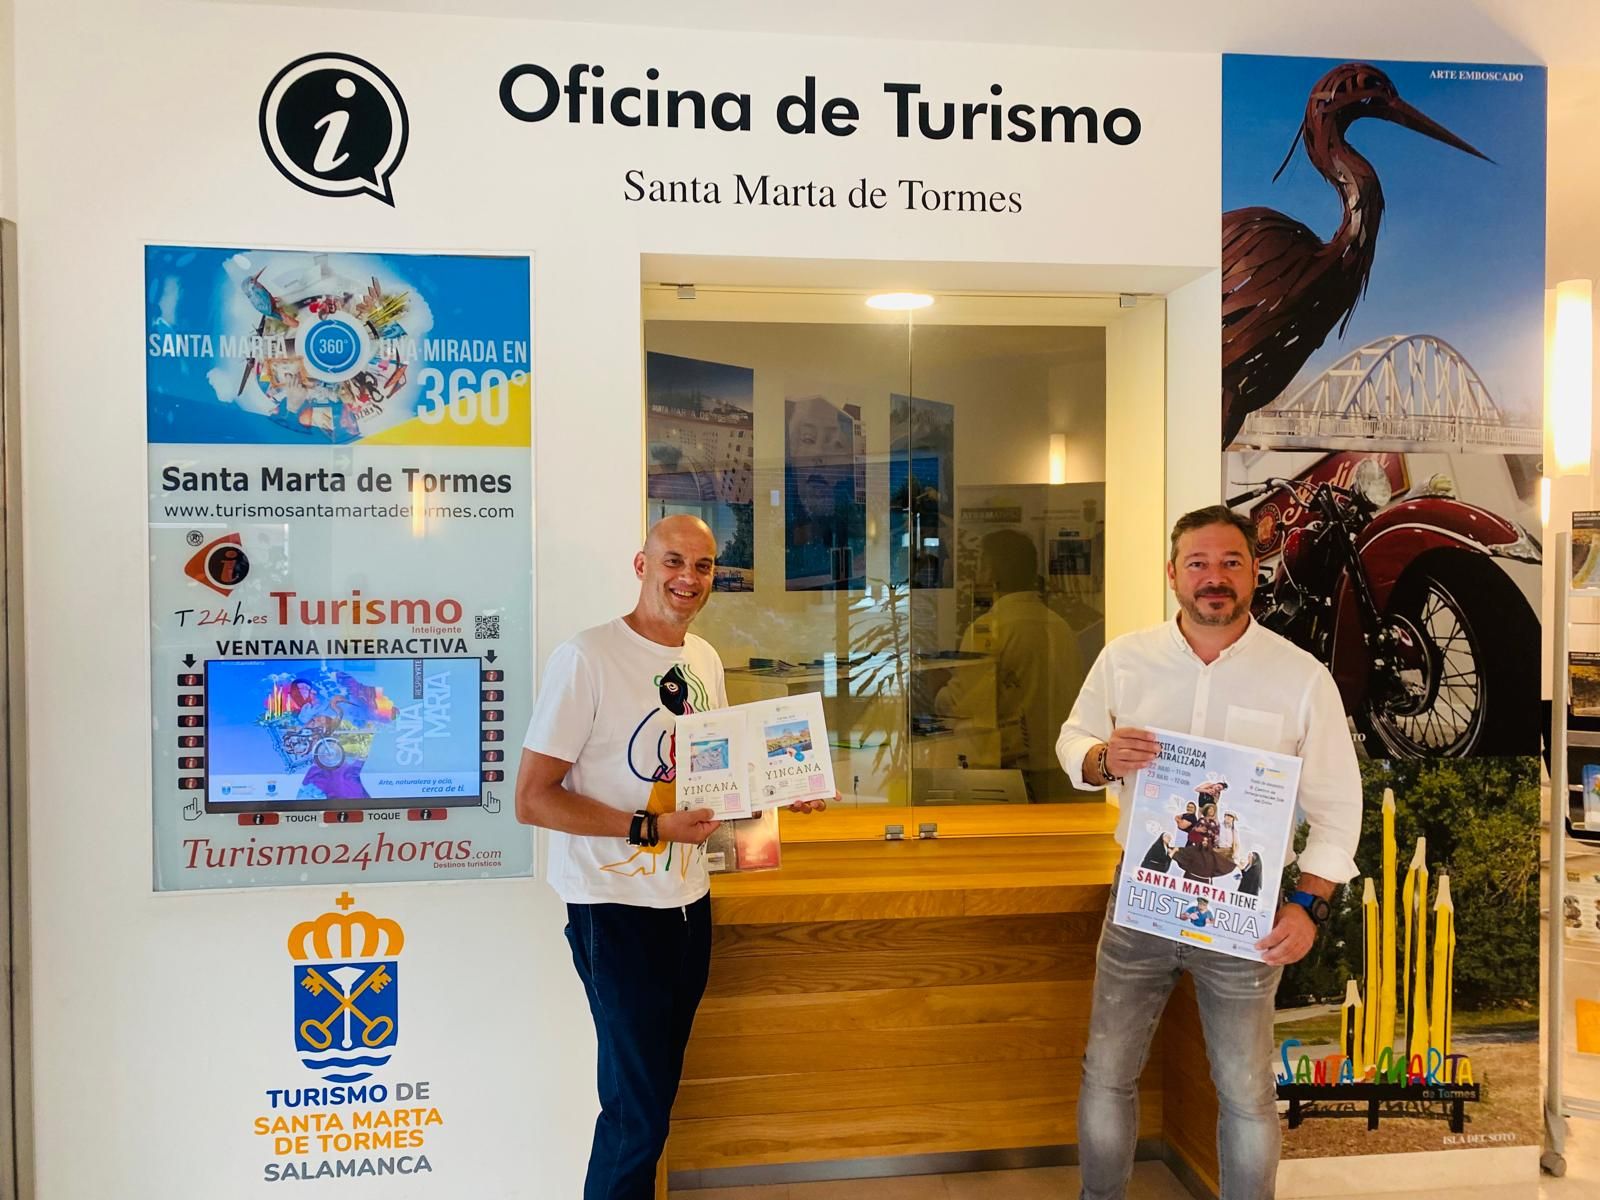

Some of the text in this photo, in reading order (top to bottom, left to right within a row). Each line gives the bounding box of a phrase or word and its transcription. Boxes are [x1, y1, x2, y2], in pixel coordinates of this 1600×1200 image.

[1429, 69, 1524, 82] ARTE EMBOSCADO
[499, 63, 1142, 146] Oficina de Turismo
[623, 169, 1023, 214] Santa Marta de Tormes
[149, 333, 288, 359] SANTA MARTA
[423, 338, 498, 363] MIRADA
[503, 340, 527, 364] EN
[162, 466, 512, 494] Santa Marta de Tormes
[164, 502, 515, 519] www.turismosantamartadermes.com
[269, 589, 463, 626] Turismo
[411, 625, 462, 635] Inteligente
[216, 637, 468, 656] VENTANA INTERACTIVA
[1156, 751, 1206, 769] ATRALIZADA
[1157, 741, 1207, 760] SITA GUIADA
[765, 762, 821, 780] YINCANA
[683, 781, 738, 796] YINCANA
[286, 814, 317, 823] TOUCH
[368, 812, 400, 821] TOQUE
[433, 861, 466, 869] Destinos
[1136, 869, 1258, 911] SANTA MARTA TIENE
[1127, 885, 1260, 940] HISTRIA
[266, 1081, 430, 1109] TURISMO DE
[1438, 1087, 1477, 1099] Tormes
[254, 1107, 444, 1136] SANTA MARTA
[274, 1129, 425, 1156] DE TORMES
[1443, 1132, 1516, 1145] ISLA DEL SOTO
[263, 1154, 433, 1182] SALAMANCA
